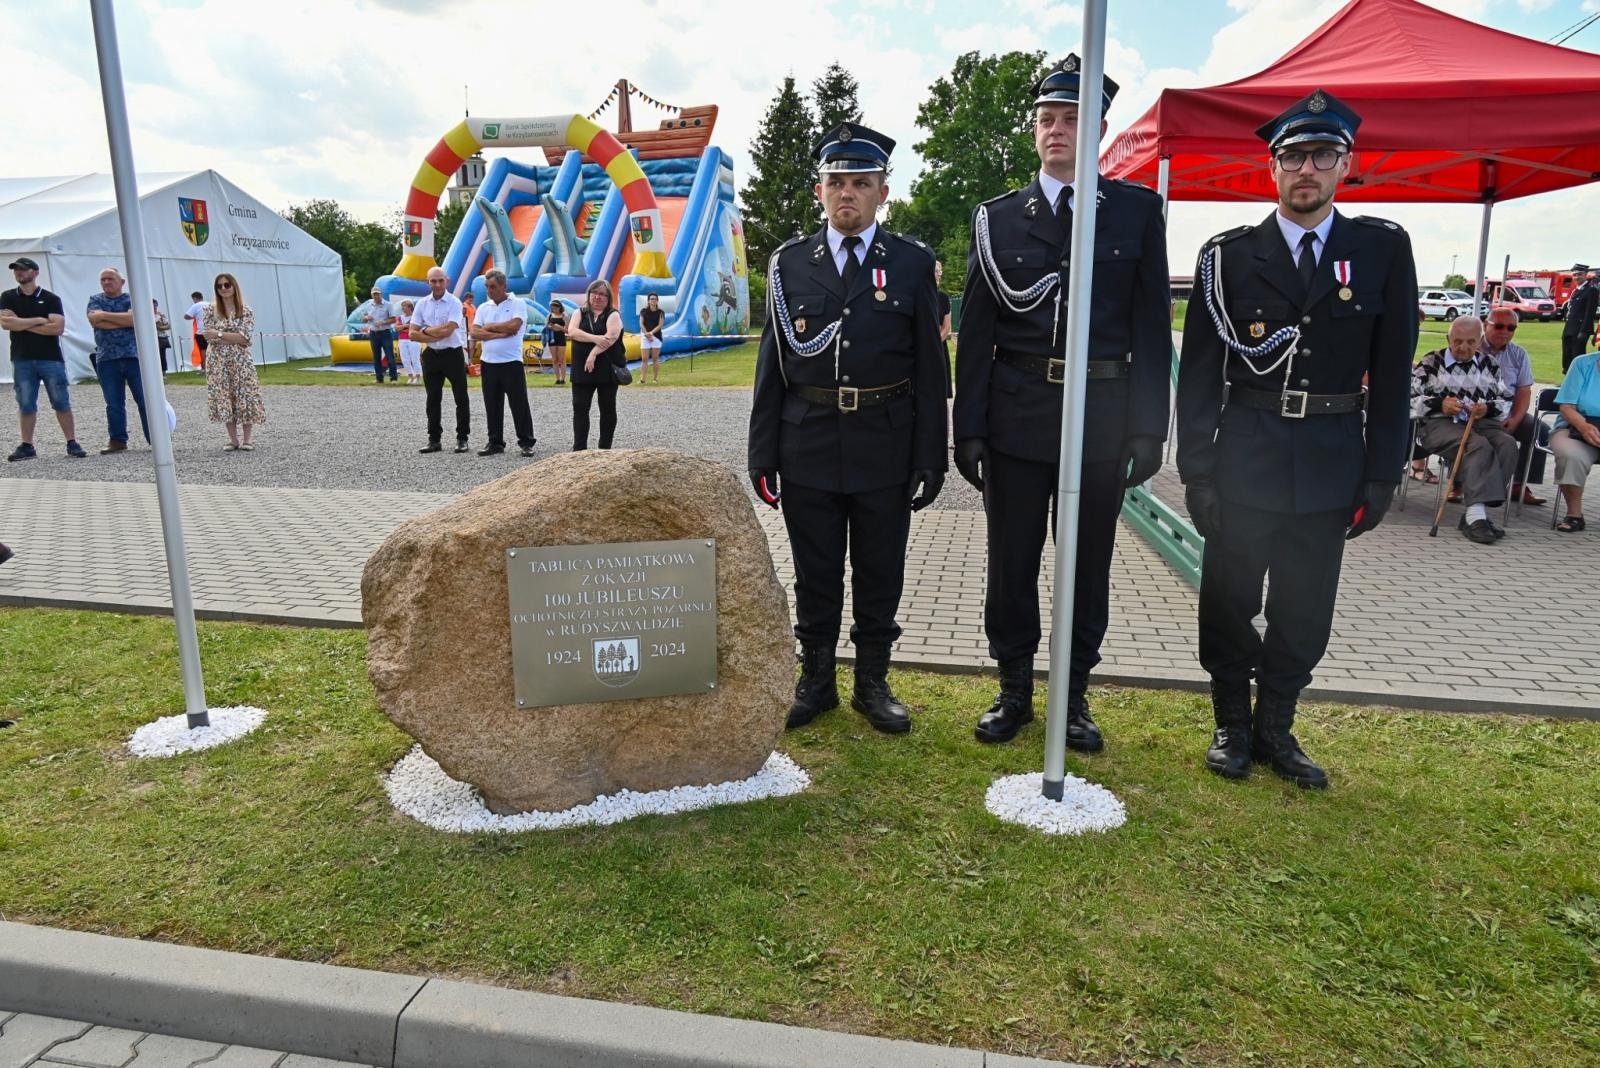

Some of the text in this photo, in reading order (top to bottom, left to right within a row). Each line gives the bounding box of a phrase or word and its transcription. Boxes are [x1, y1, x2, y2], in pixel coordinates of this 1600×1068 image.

[228, 203, 257, 219] Gmina
[231, 233, 290, 250] Krzyżanowice
[528, 552, 695, 573] TABLICA PAMIĄTKOWA
[581, 571, 646, 586] Z OKAZJI
[544, 585, 685, 607] 100 JUBILEUSZU
[513, 610, 600, 624] OCHOTNICZEJ
[561, 617, 685, 636] RUDYSZWALDZIE
[546, 642, 686, 665] 1924 2024
